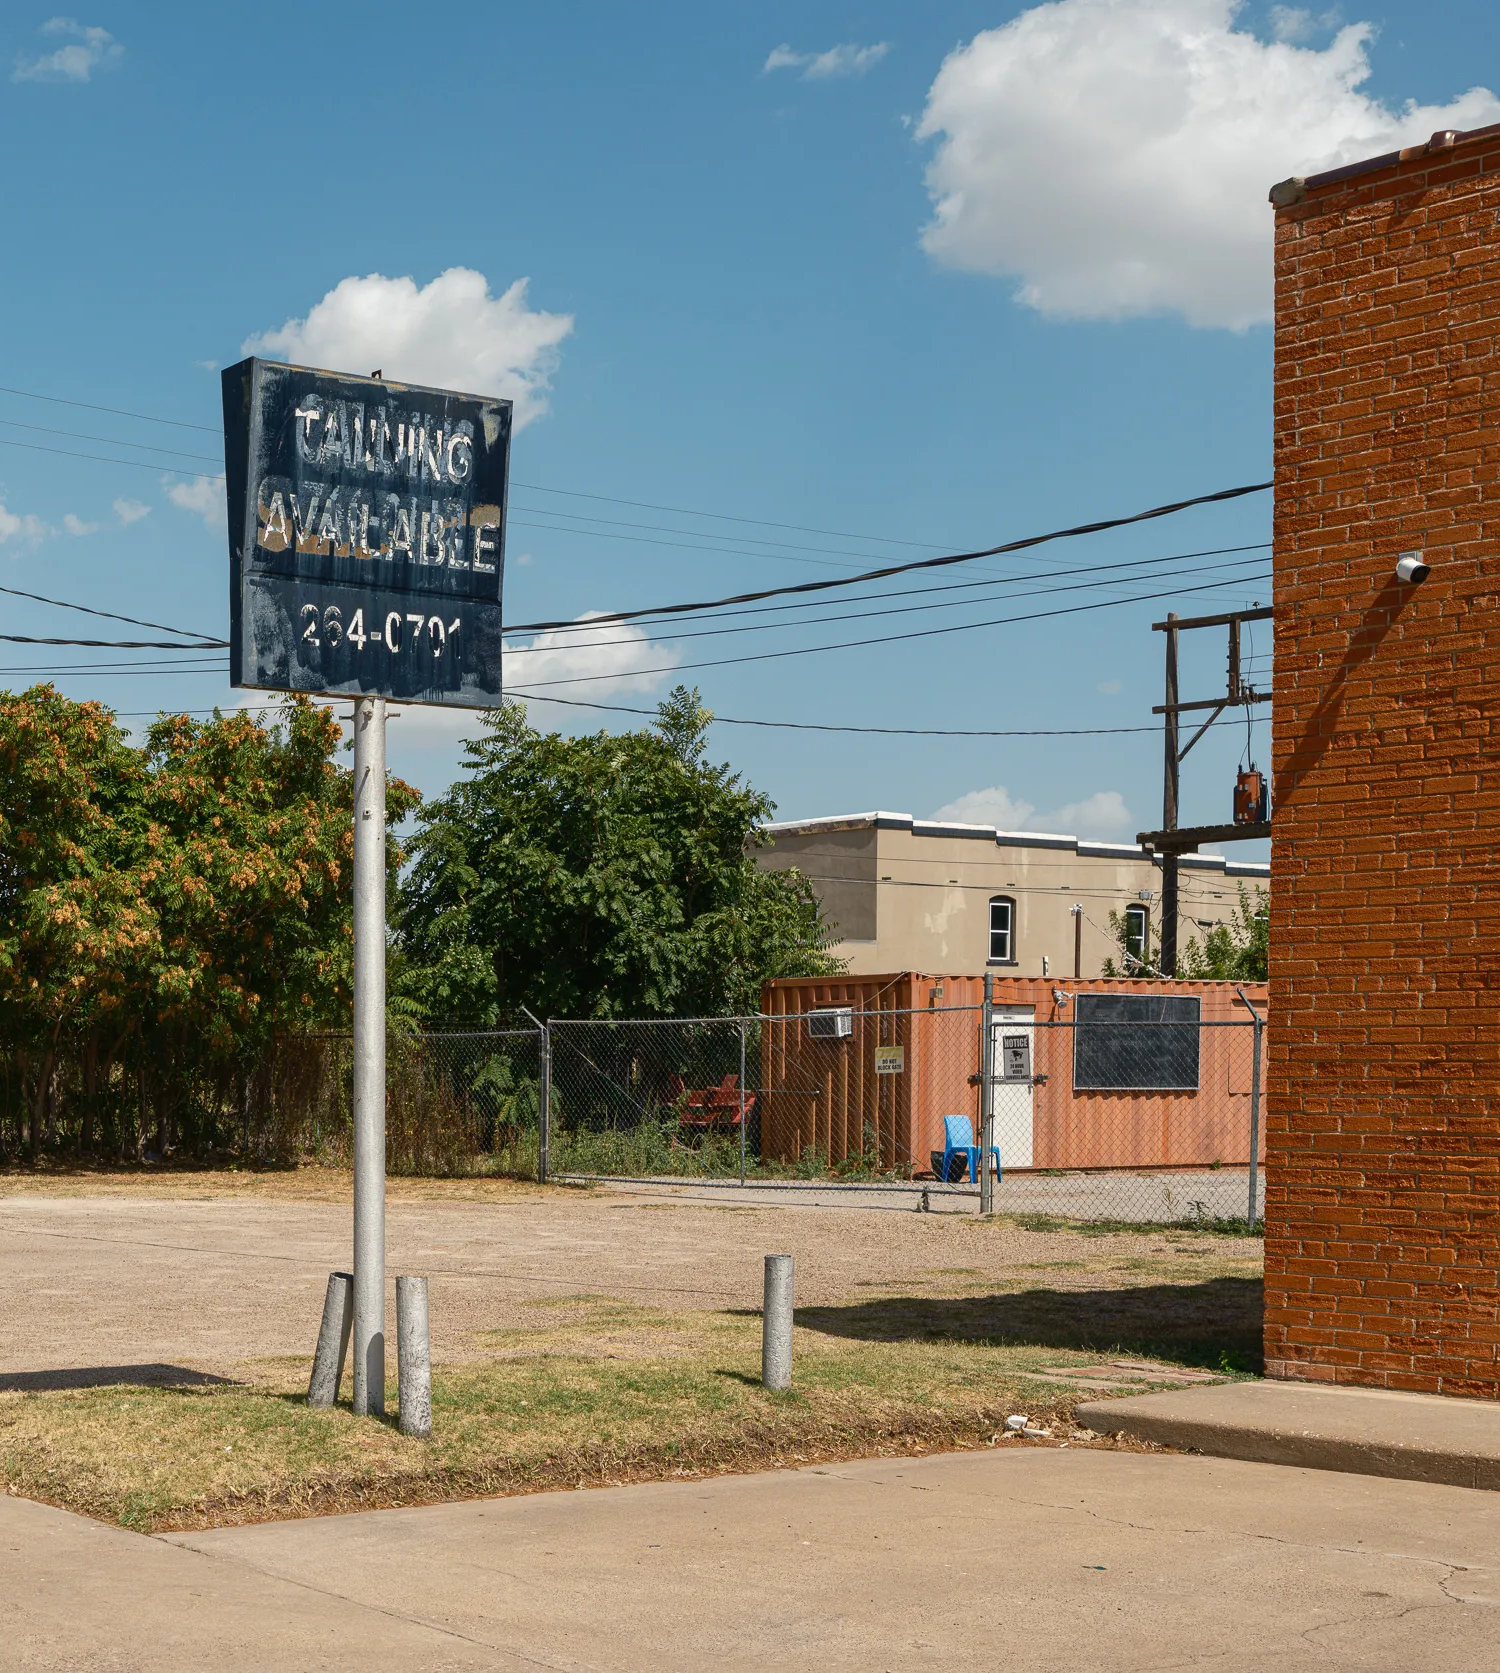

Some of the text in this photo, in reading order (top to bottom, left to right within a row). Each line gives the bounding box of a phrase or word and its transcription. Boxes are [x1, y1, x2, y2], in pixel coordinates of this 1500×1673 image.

[263, 491, 496, 573] AVAILABLE
[300, 603, 462, 659] 264-0701
[1004, 1038, 1028, 1048] NOTICE
